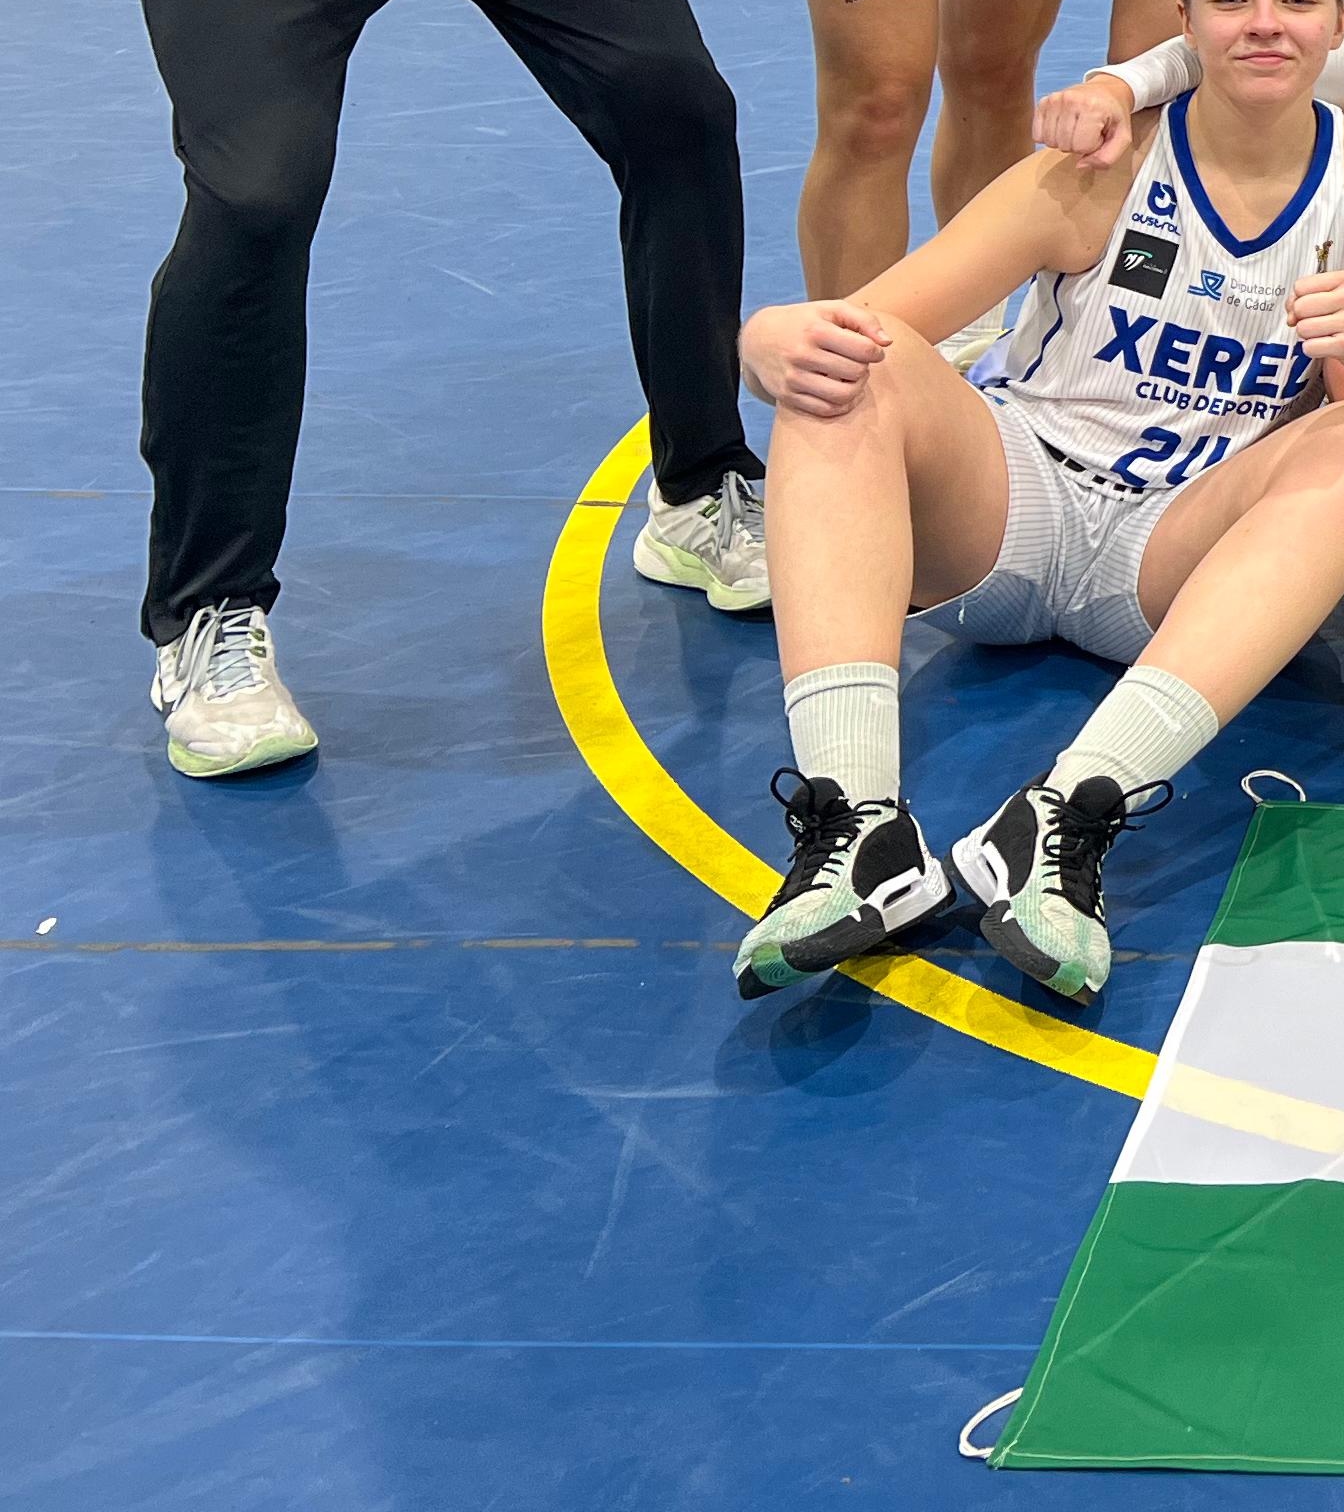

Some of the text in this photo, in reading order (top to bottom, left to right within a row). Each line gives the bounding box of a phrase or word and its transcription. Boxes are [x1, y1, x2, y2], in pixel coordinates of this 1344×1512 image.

[1131, 212, 1182, 236] austral
[1230, 278, 1286, 297] Diputación
[1226, 294, 1276, 313] de Cádiz
[1136, 381, 1190, 411] CLUB
